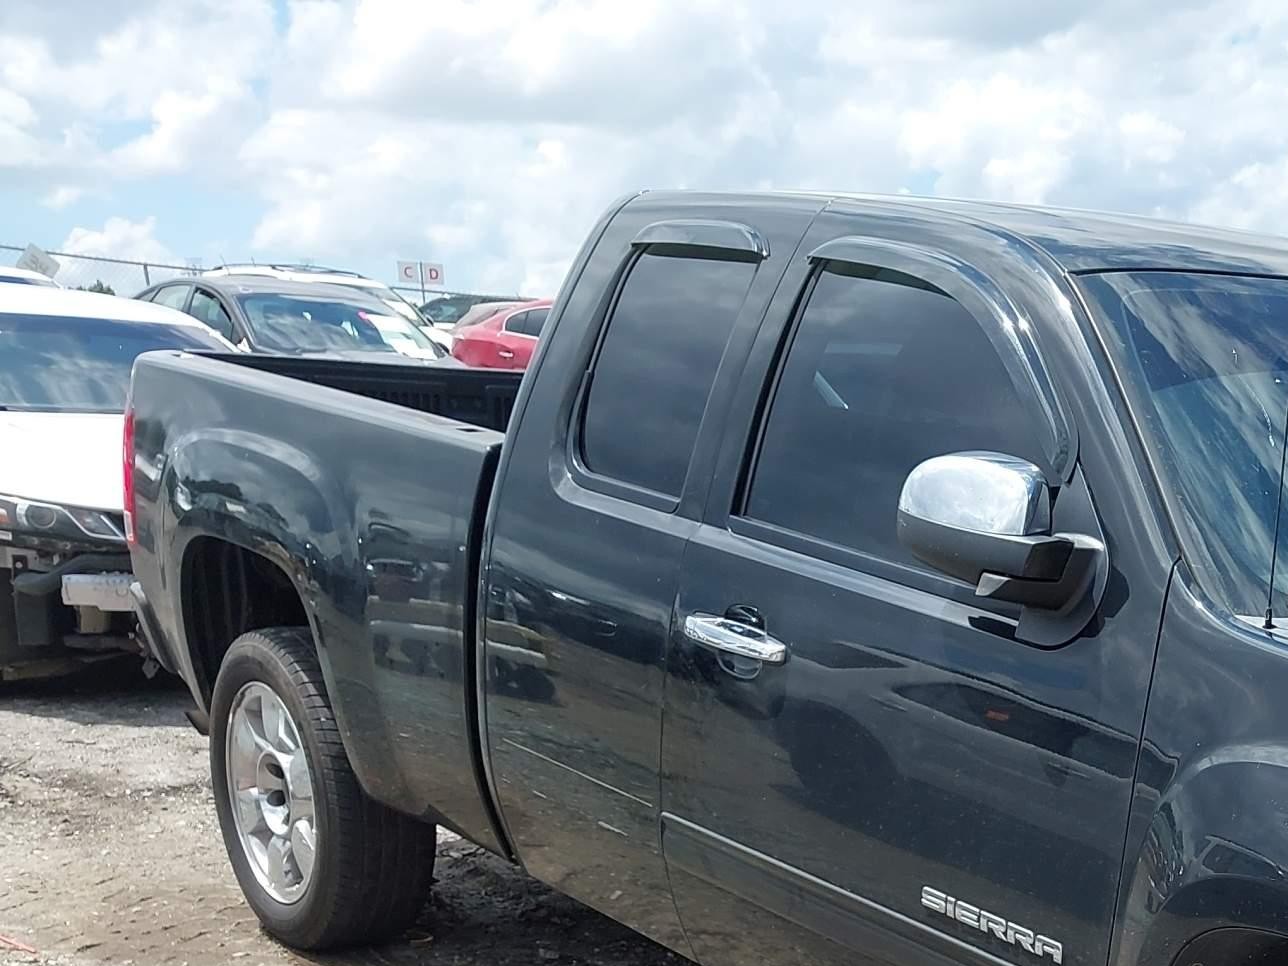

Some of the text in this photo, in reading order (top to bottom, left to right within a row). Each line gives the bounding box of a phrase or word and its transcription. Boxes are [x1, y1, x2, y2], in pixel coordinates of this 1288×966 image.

[403, 266, 413, 278] C
[429, 268, 439, 280] D
[920, 885, 1065, 965] SIERRA
